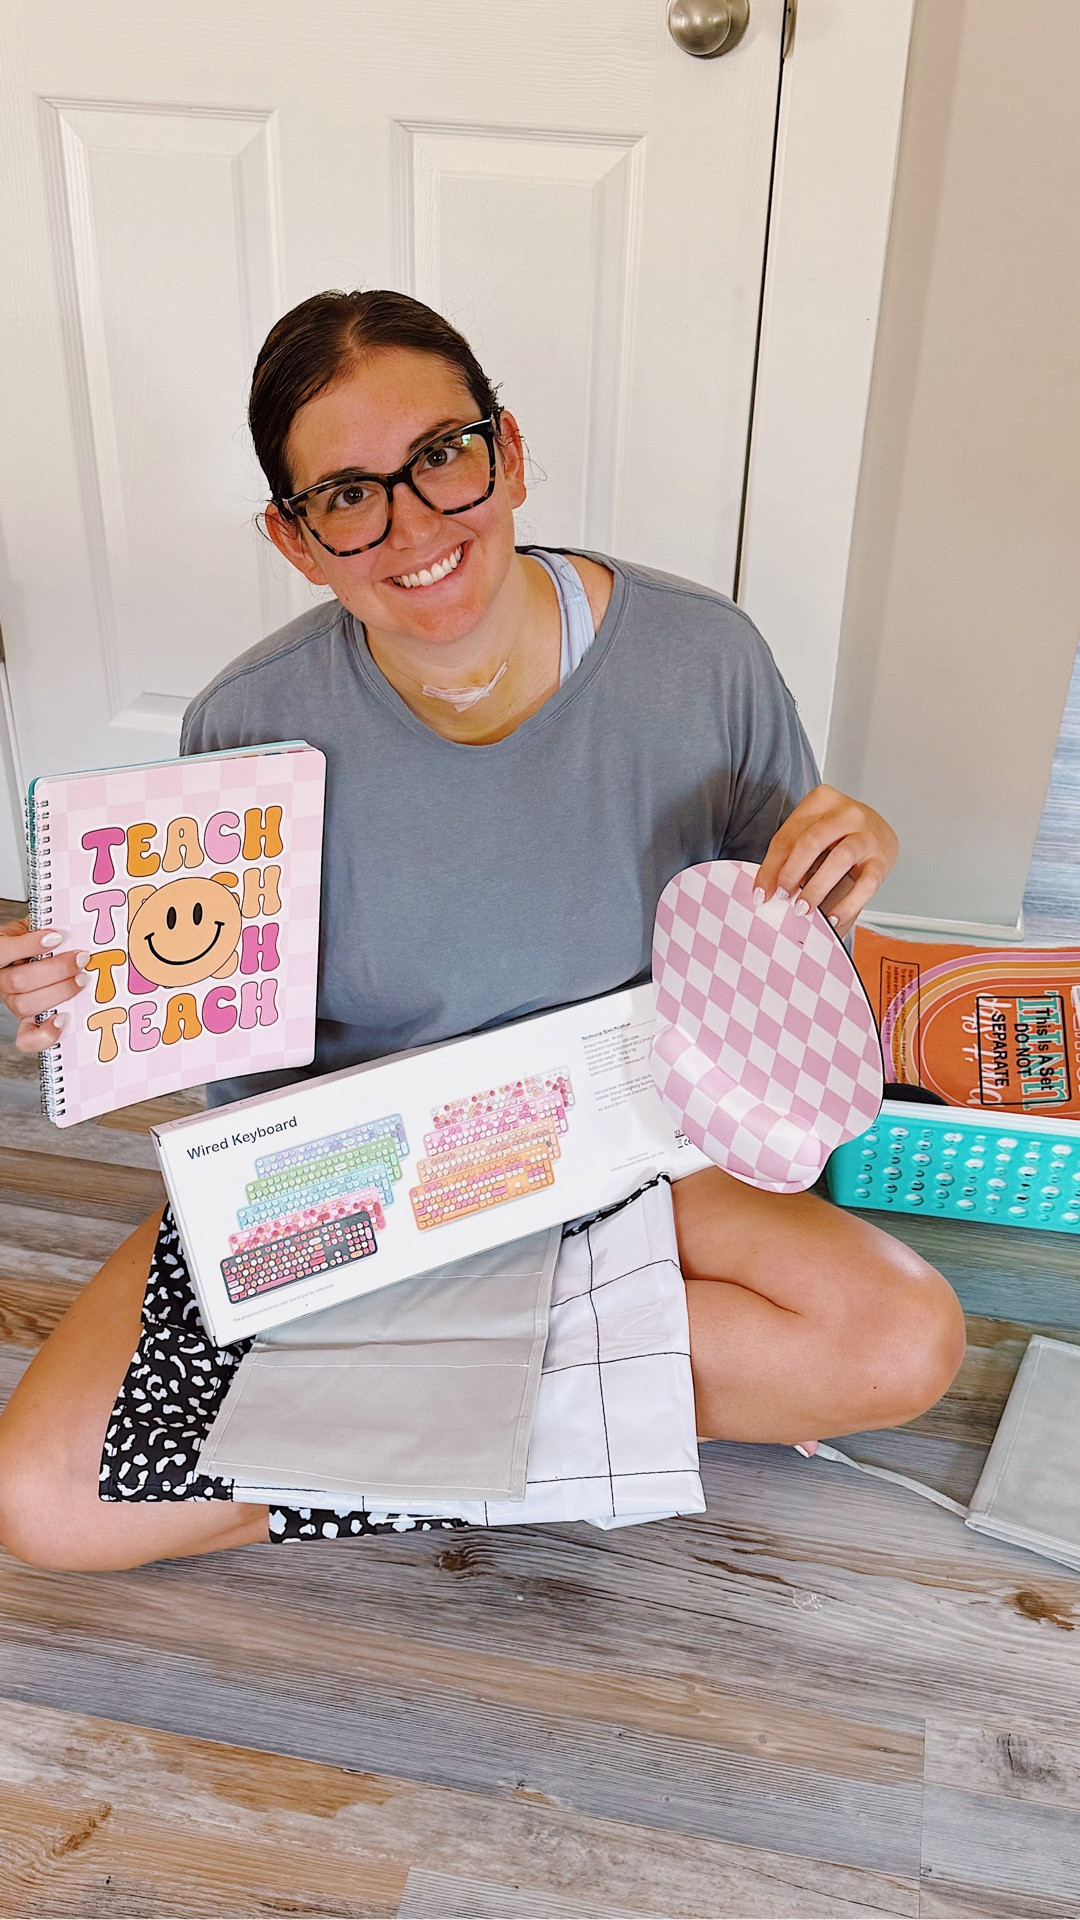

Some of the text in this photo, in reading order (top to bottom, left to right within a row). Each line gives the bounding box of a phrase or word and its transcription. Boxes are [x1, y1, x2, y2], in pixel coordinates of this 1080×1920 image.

[81, 805, 283, 885] TEACH
[87, 978, 279, 1063] TEACH
[991, 1013, 1010, 1087] SEPARATE
[1014, 1023, 1032, 1077] DO NOT
[1035, 1007, 1055, 1091] This Is A Set
[186, 1116, 298, 1160] Wired Keyboard
